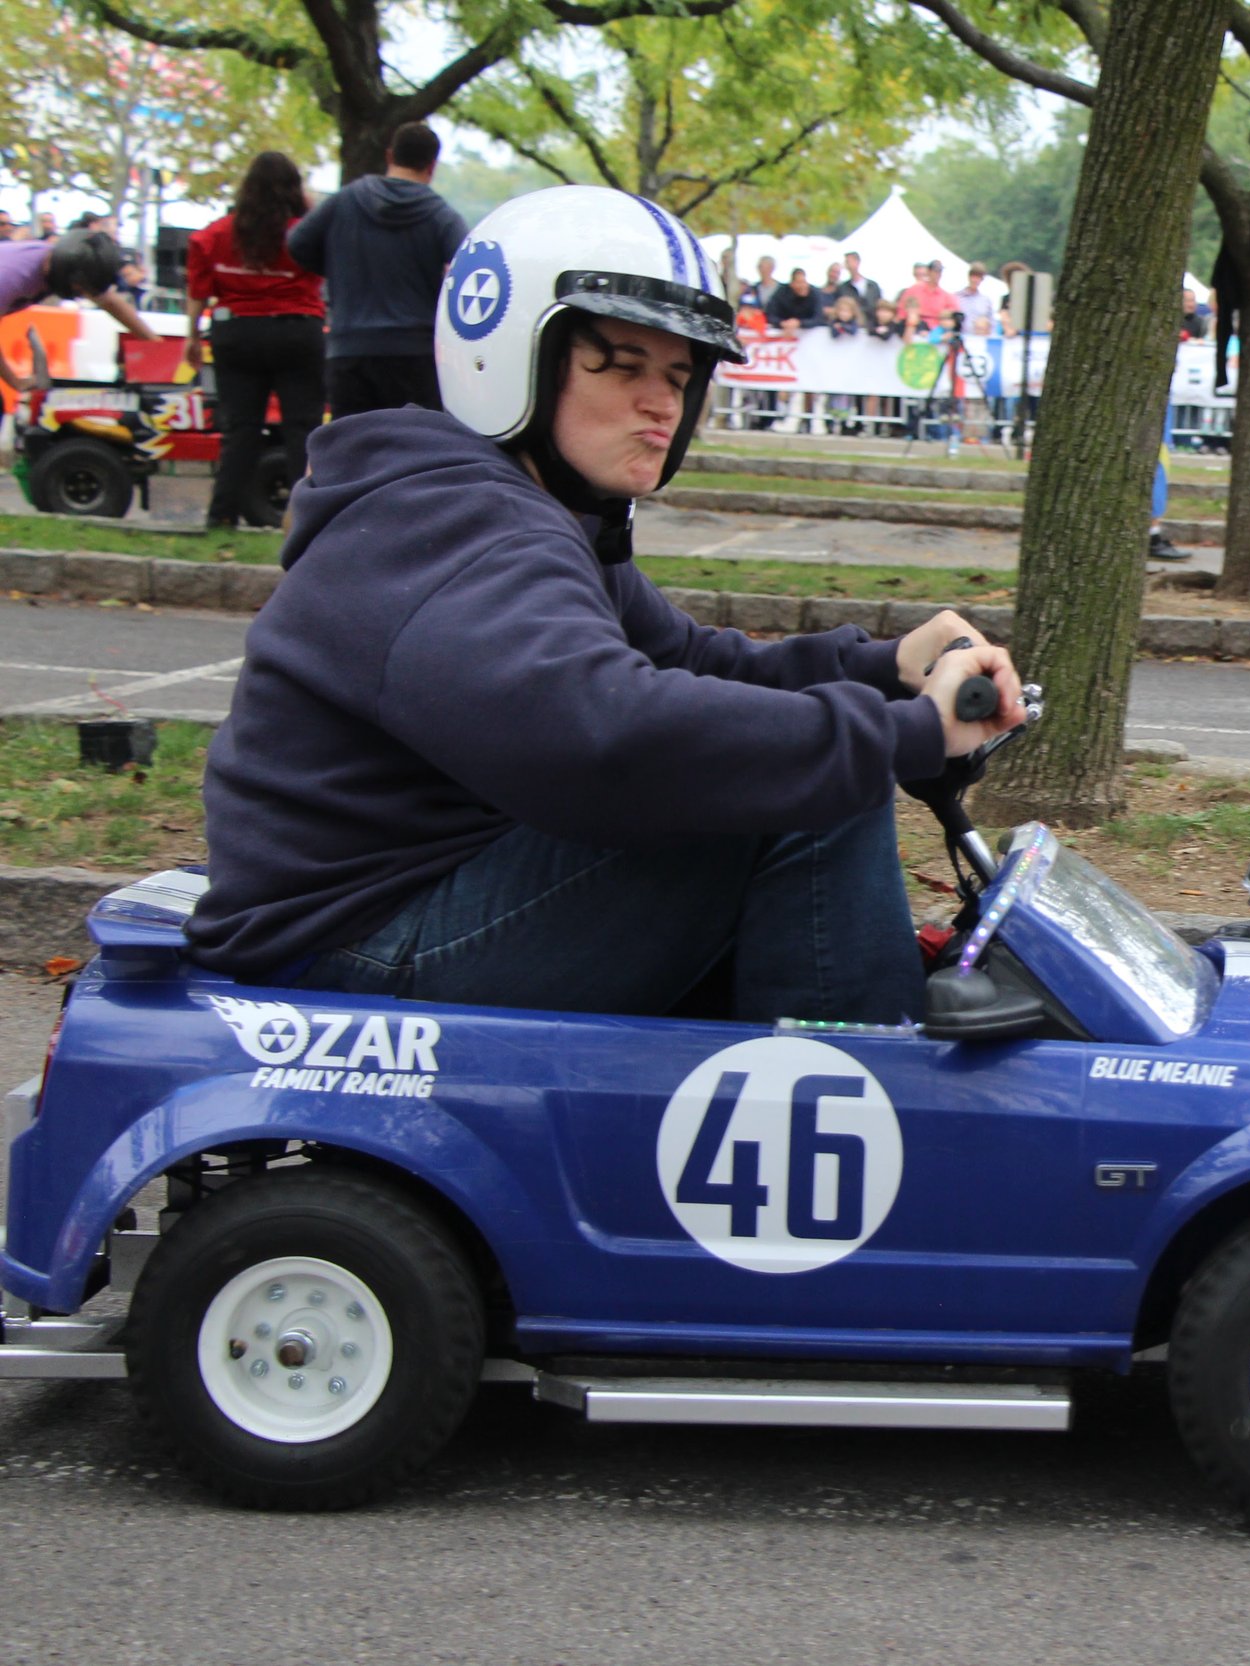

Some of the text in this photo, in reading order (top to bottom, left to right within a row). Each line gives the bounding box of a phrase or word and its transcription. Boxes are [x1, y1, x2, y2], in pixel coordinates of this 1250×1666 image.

[250, 1066, 435, 1098] FAMILY RACING
[1089, 1056, 1238, 1087] BLUE MEANIE
[675, 1070, 866, 1241] 46
[1096, 1163, 1158, 1187] GT
